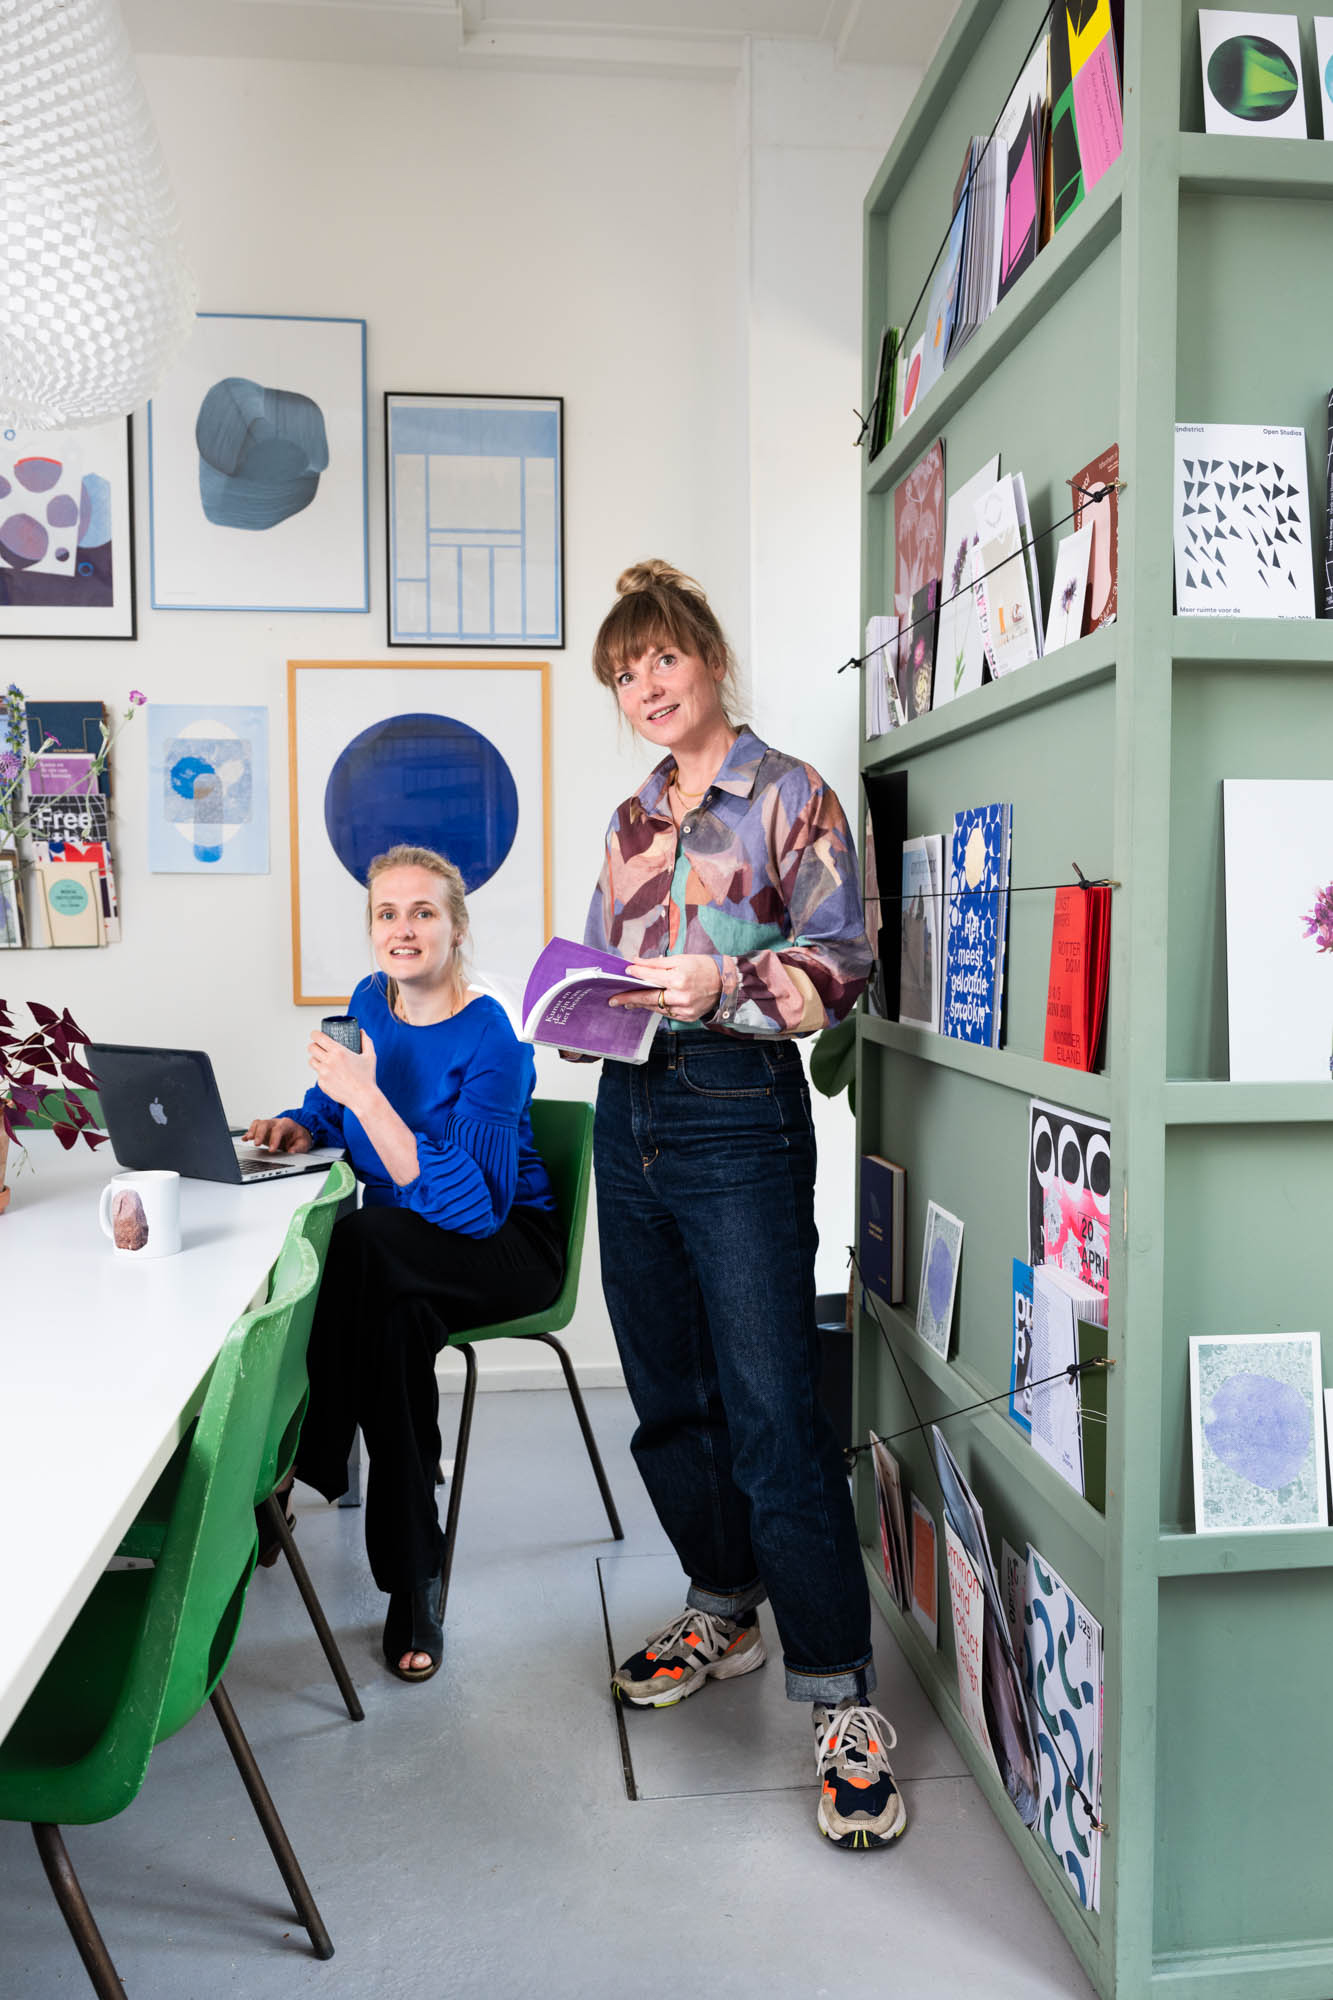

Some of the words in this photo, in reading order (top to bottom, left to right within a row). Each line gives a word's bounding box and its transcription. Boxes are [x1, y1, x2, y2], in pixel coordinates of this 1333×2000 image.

[1262, 428, 1279, 436] Open
[1280, 429, 1302, 437] Studios
[38, 808, 92, 830] Free
[964, 914, 979, 938] Het
[957, 945, 984, 967] meest
[1081, 1217, 1094, 1242] 20
[1081, 1247, 1110, 1281] APRIL
